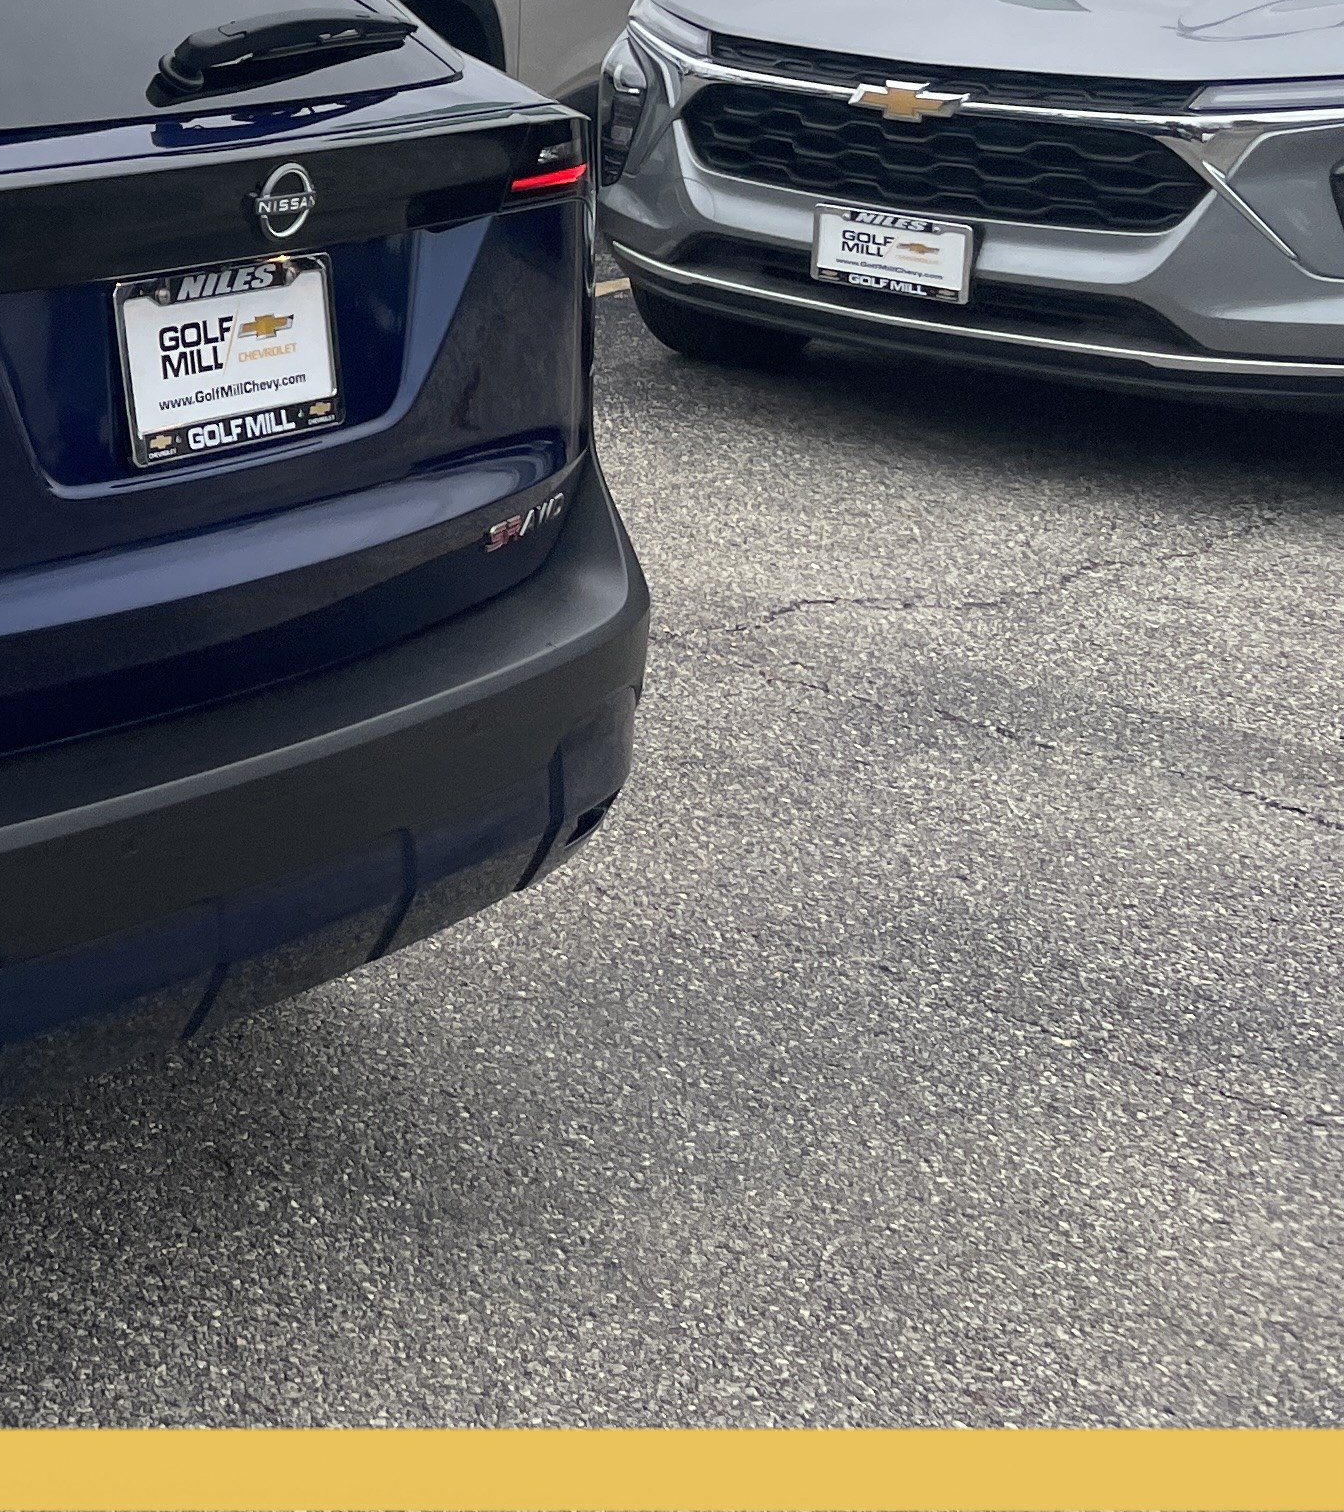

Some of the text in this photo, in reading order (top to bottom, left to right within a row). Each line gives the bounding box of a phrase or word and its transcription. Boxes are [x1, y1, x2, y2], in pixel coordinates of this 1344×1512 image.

[258, 195, 316, 213] NISSAN
[854, 212, 929, 233] NILES
[841, 240, 884, 258] MILL
[842, 229, 895, 247] GOLF
[176, 263, 276, 301] NILES
[848, 274, 928, 296] GOLF MILL
[158, 315, 234, 353] GOLF
[161, 345, 224, 380] MILL
[237, 342, 298, 364] CHEVROLET
[158, 373, 307, 412] www.GolfMillChevy.com
[187, 409, 296, 451] GOLF MILL
